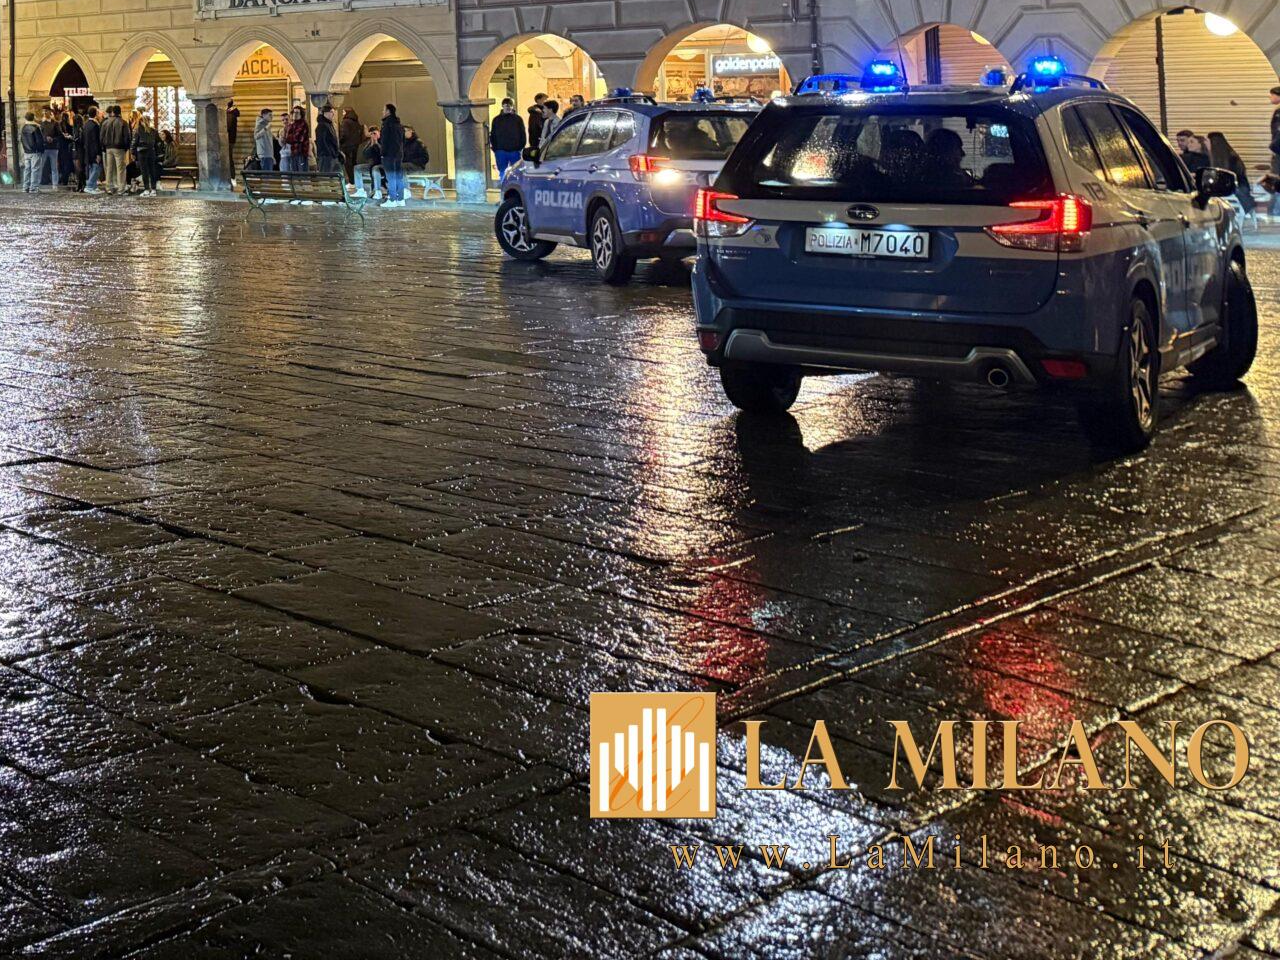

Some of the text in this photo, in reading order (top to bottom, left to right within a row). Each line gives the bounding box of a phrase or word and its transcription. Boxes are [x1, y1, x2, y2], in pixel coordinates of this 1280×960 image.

[715, 56, 781, 73] goldenpoint
[534, 190, 583, 209] POLIZIA
[810, 232, 925, 255] POLIZIA M7040
